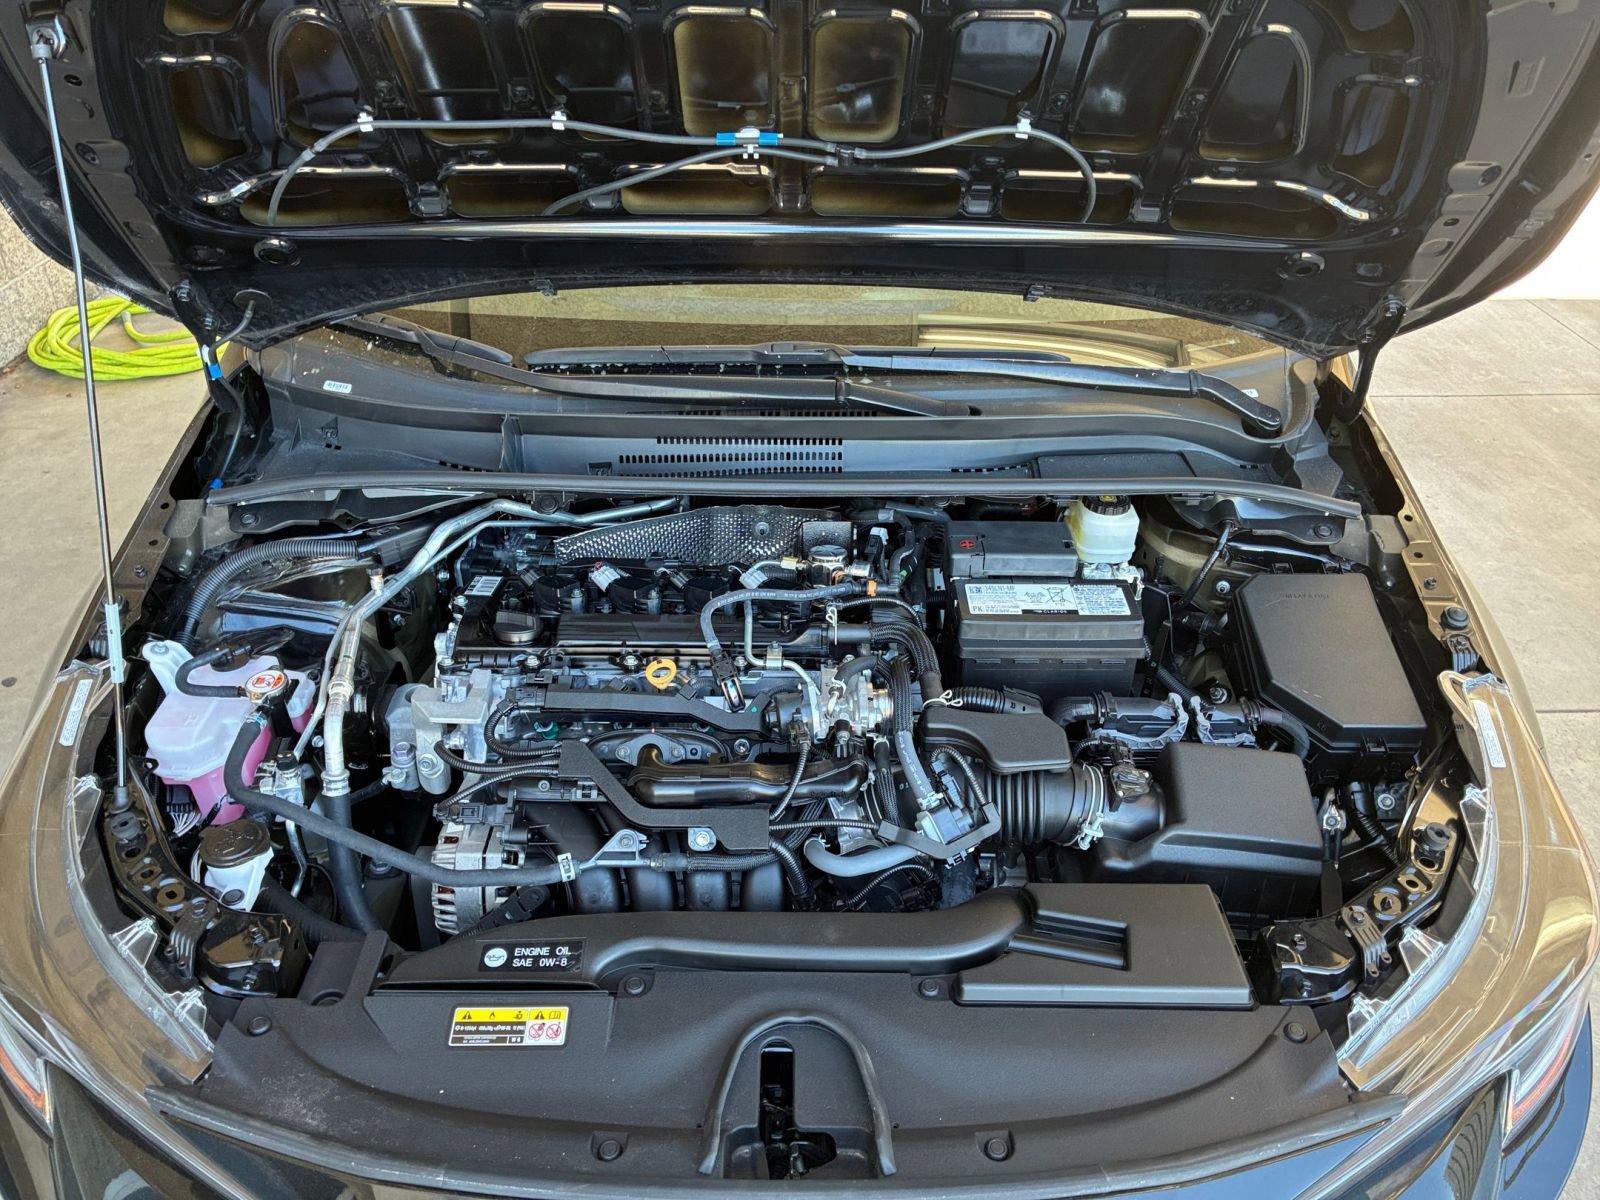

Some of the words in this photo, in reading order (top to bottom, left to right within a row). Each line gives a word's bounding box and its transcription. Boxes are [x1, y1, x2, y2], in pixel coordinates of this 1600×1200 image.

[514, 947, 551, 957] ENGINE
[555, 946, 572, 956] OIL
[512, 958, 533, 967] SAE
[539, 958, 568, 967] 0W-8
